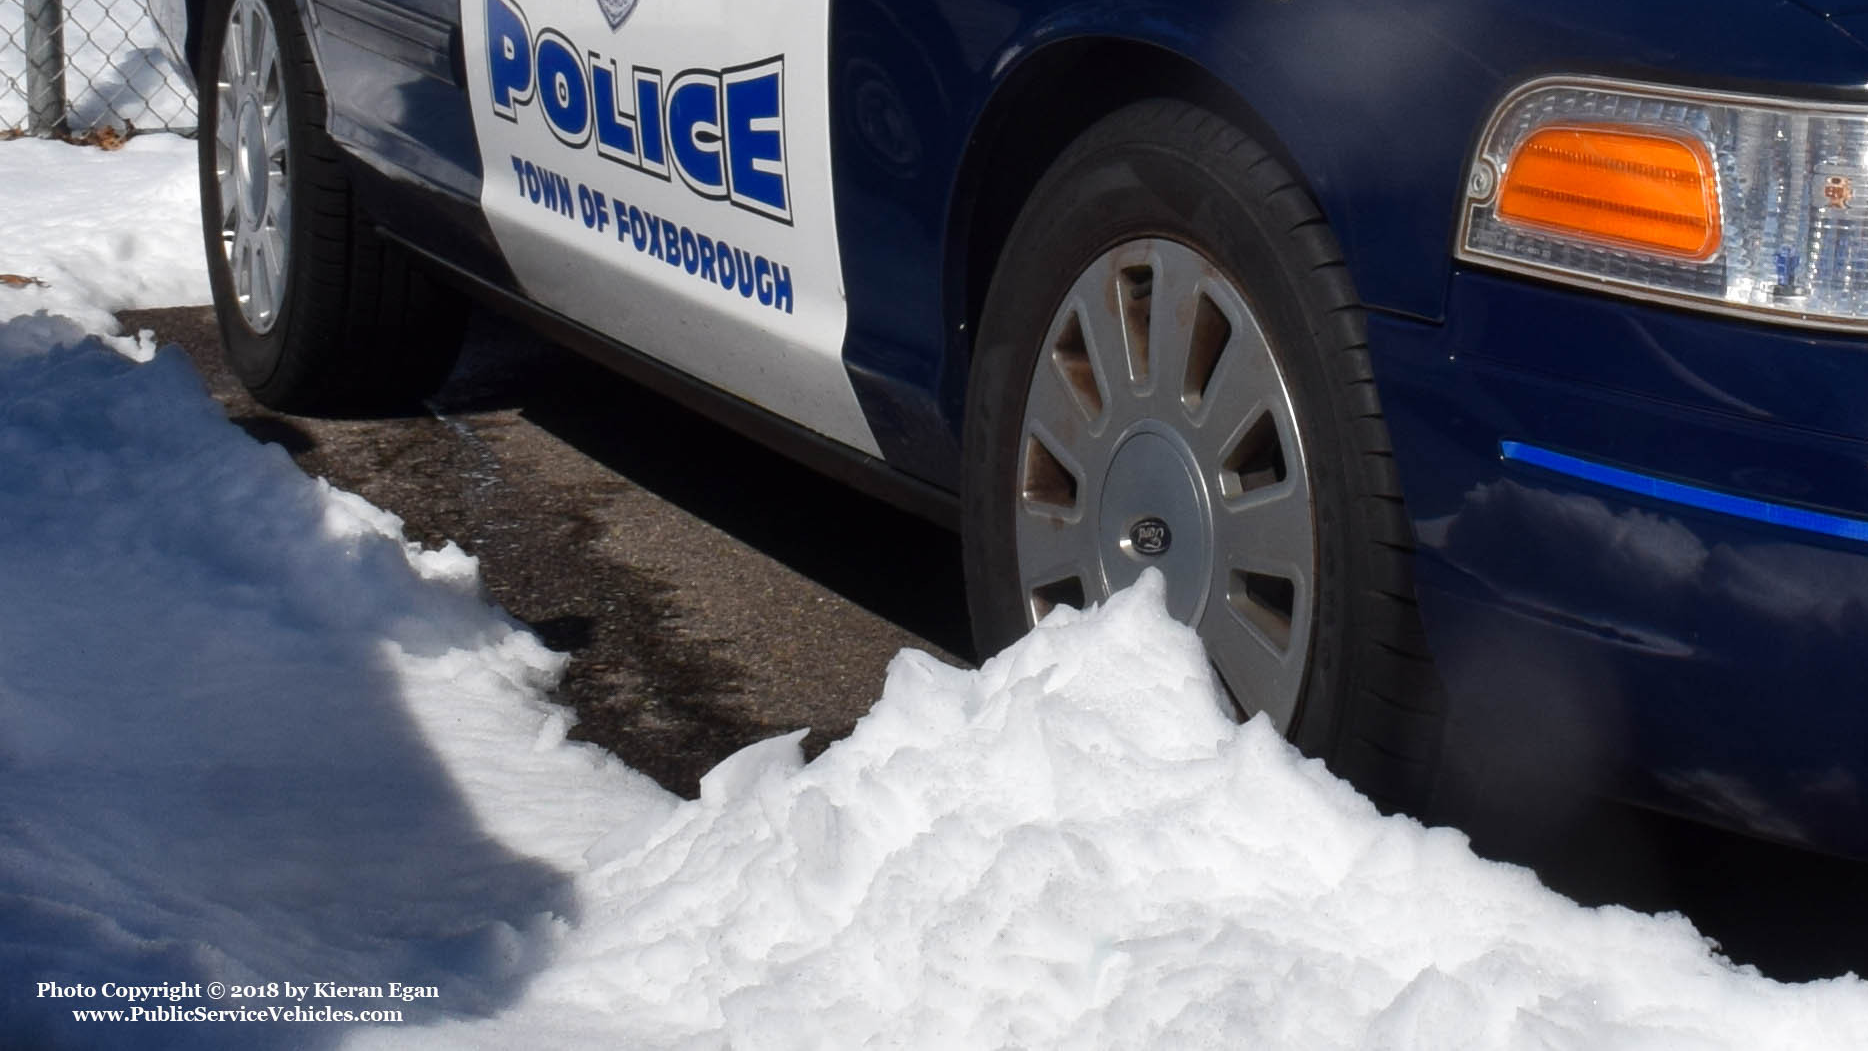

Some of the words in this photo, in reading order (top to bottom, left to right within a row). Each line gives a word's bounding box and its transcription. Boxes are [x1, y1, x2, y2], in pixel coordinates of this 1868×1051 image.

[511, 155, 575, 220] TOWN
[579, 184, 610, 232] OF
[613, 198, 794, 314] FOXBOROUGH
